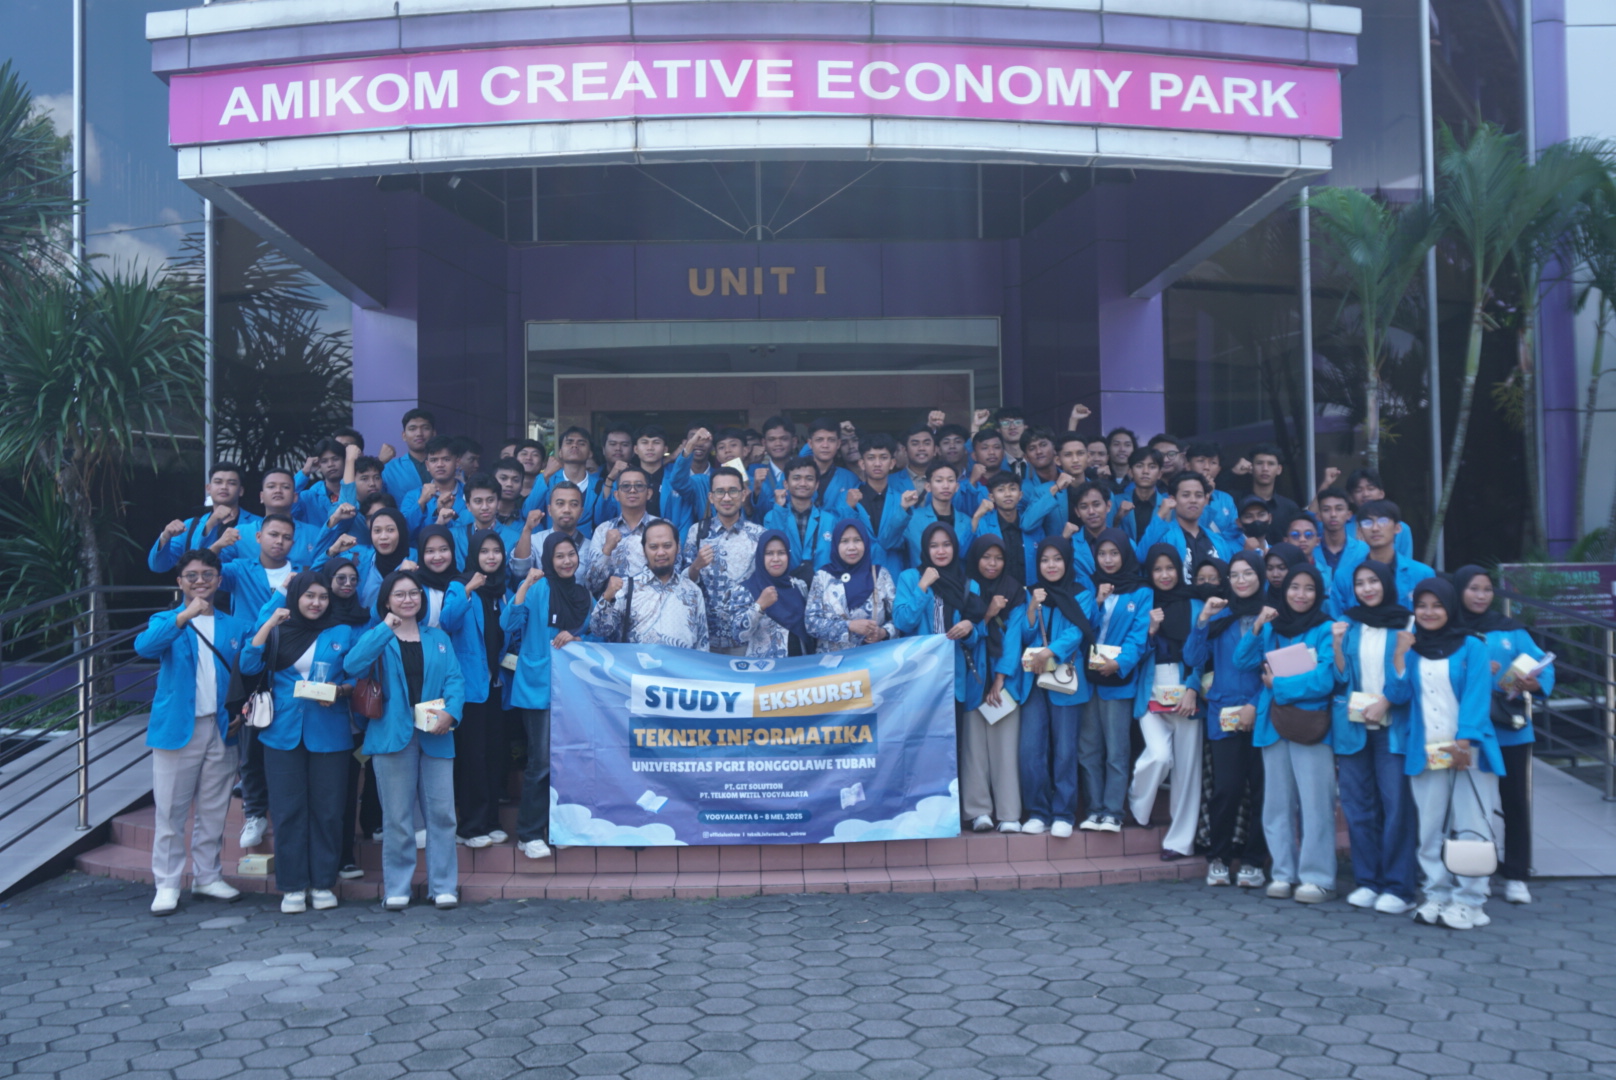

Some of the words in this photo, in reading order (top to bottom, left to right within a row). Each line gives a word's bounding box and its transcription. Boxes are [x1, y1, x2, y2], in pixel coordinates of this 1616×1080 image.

[218, 68, 459, 125] AMIKOM
[480, 58, 794, 106] CREATIVE
[817, 60, 1133, 108] ECONOMY
[1149, 71, 1299, 119] PARK
[688, 267, 795, 296] UNIT
[814, 266, 827, 294] I
[645, 685, 741, 713] STUDY
[758, 680, 864, 712] EKSKURSI
[633, 728, 711, 747] TEKNIK
[716, 725, 873, 746] INFORMATIKA
[632, 760, 713, 773] UNIVERSITAS
[715, 760, 746, 773] PGRI
[748, 759, 833, 772] RONGGOLAWE
[835, 758, 876, 769] TUBAN
[770, 813, 785, 821] MEI,
